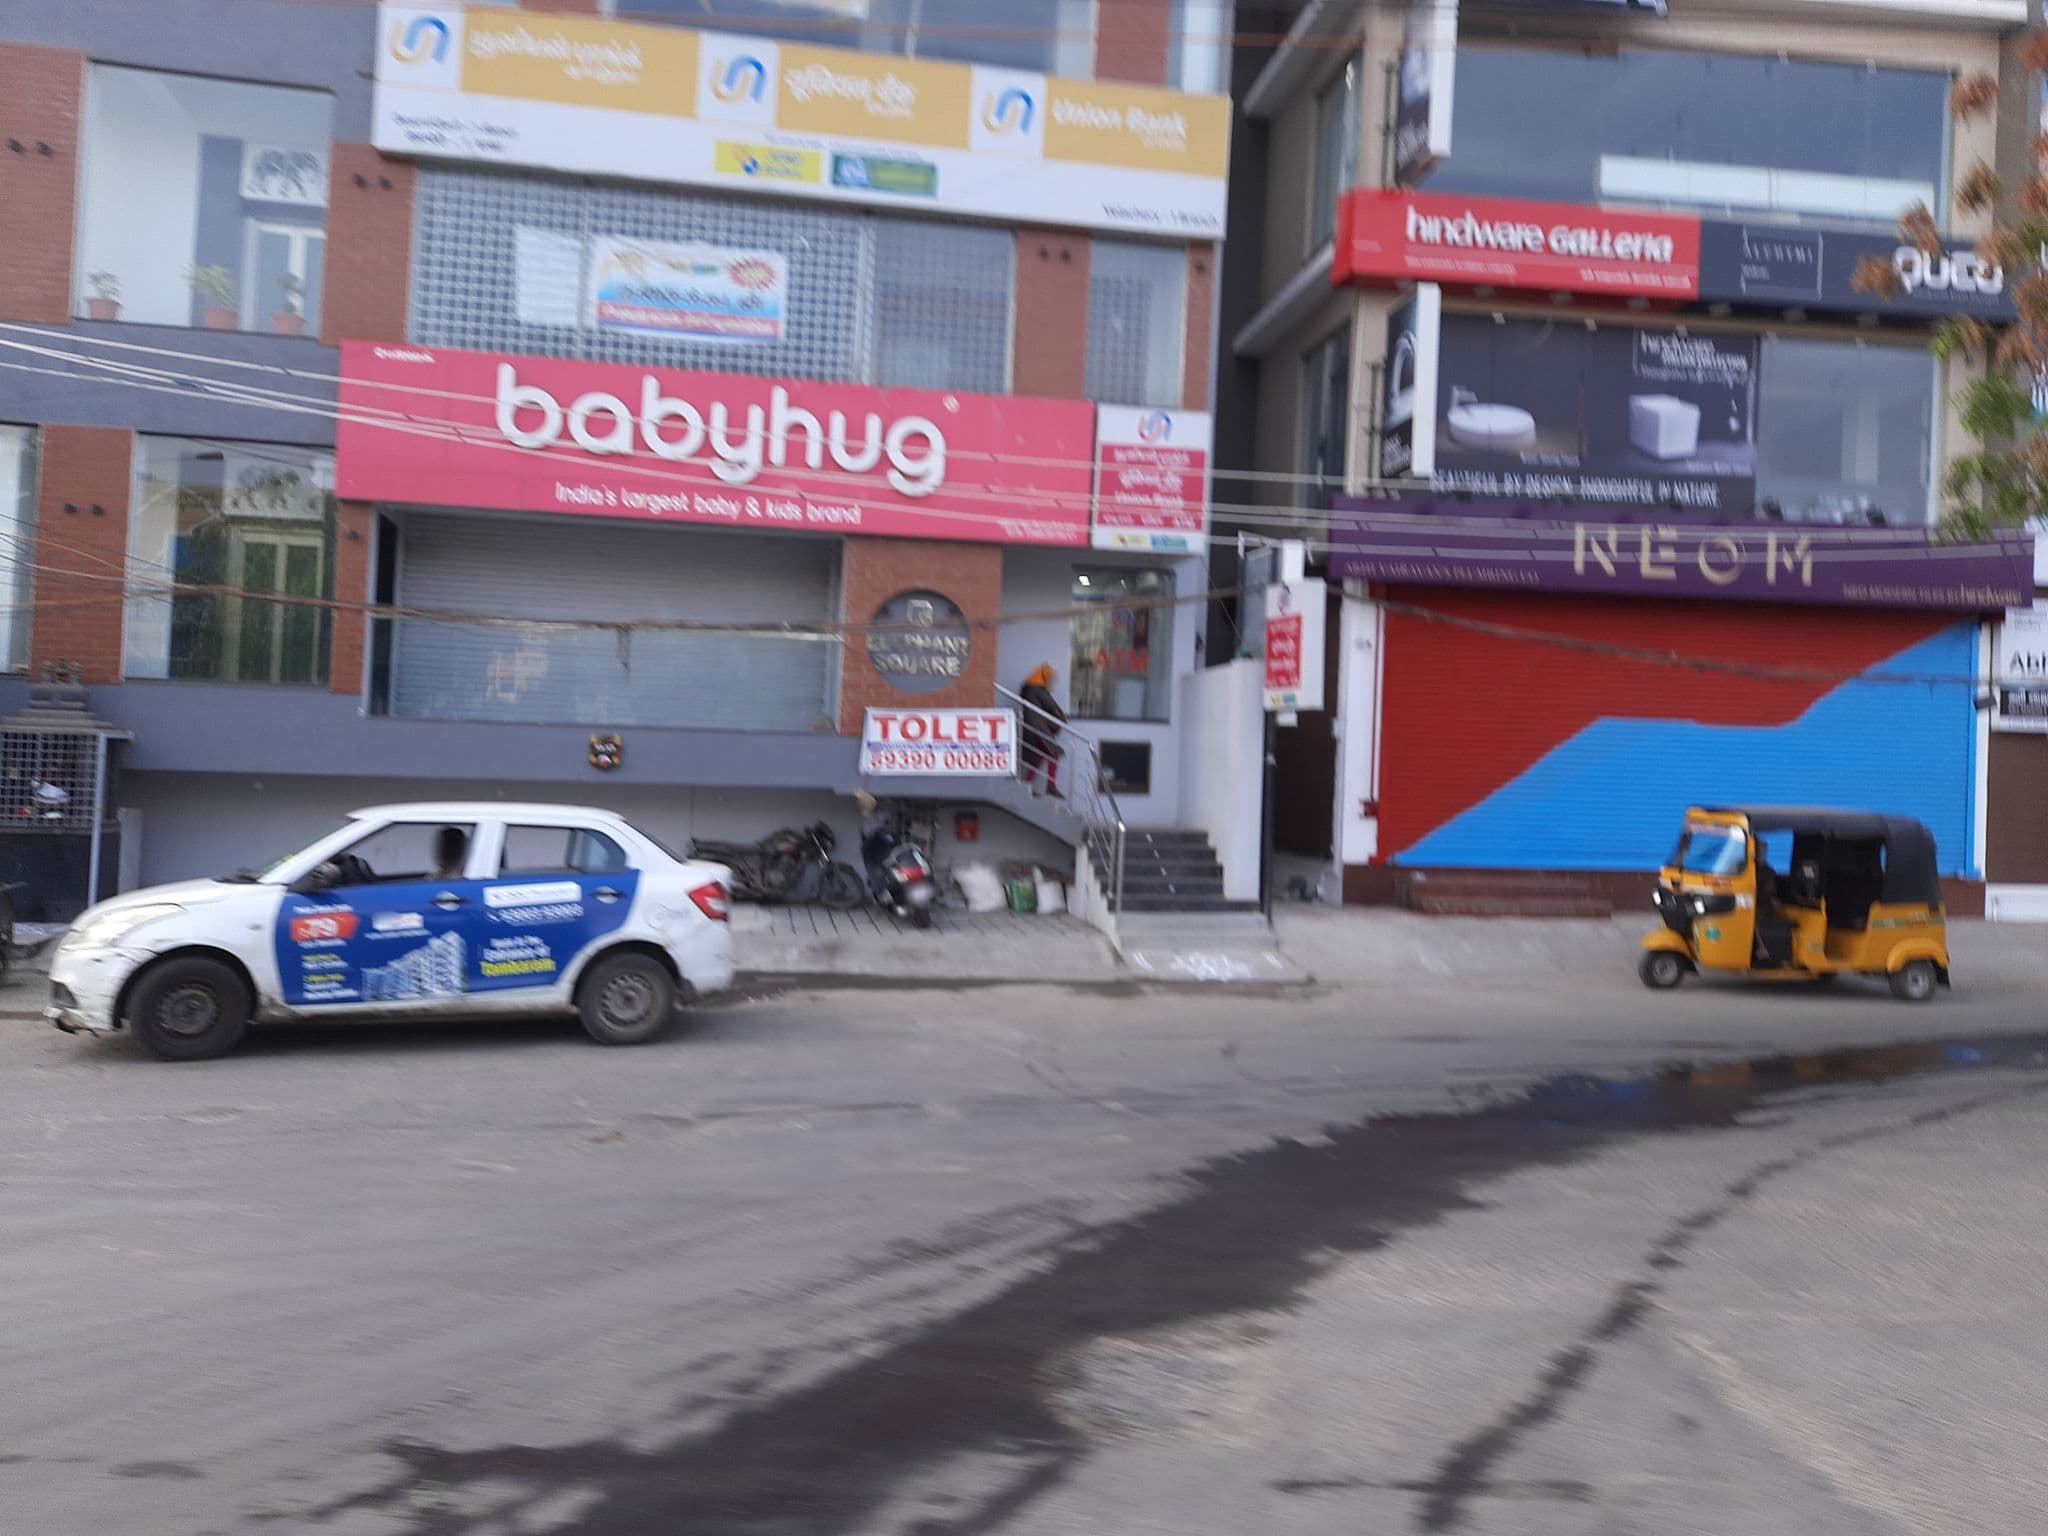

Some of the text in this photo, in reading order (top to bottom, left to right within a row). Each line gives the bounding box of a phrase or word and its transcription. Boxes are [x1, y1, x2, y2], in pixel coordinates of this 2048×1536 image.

[1406, 204, 1545, 252] hindware
[496, 362, 947, 497] babyhug
[556, 481, 861, 525] India's largest baby & kids brand
[1573, 521, 1813, 587] NEOM
[1095, 648, 1148, 672] ATM
